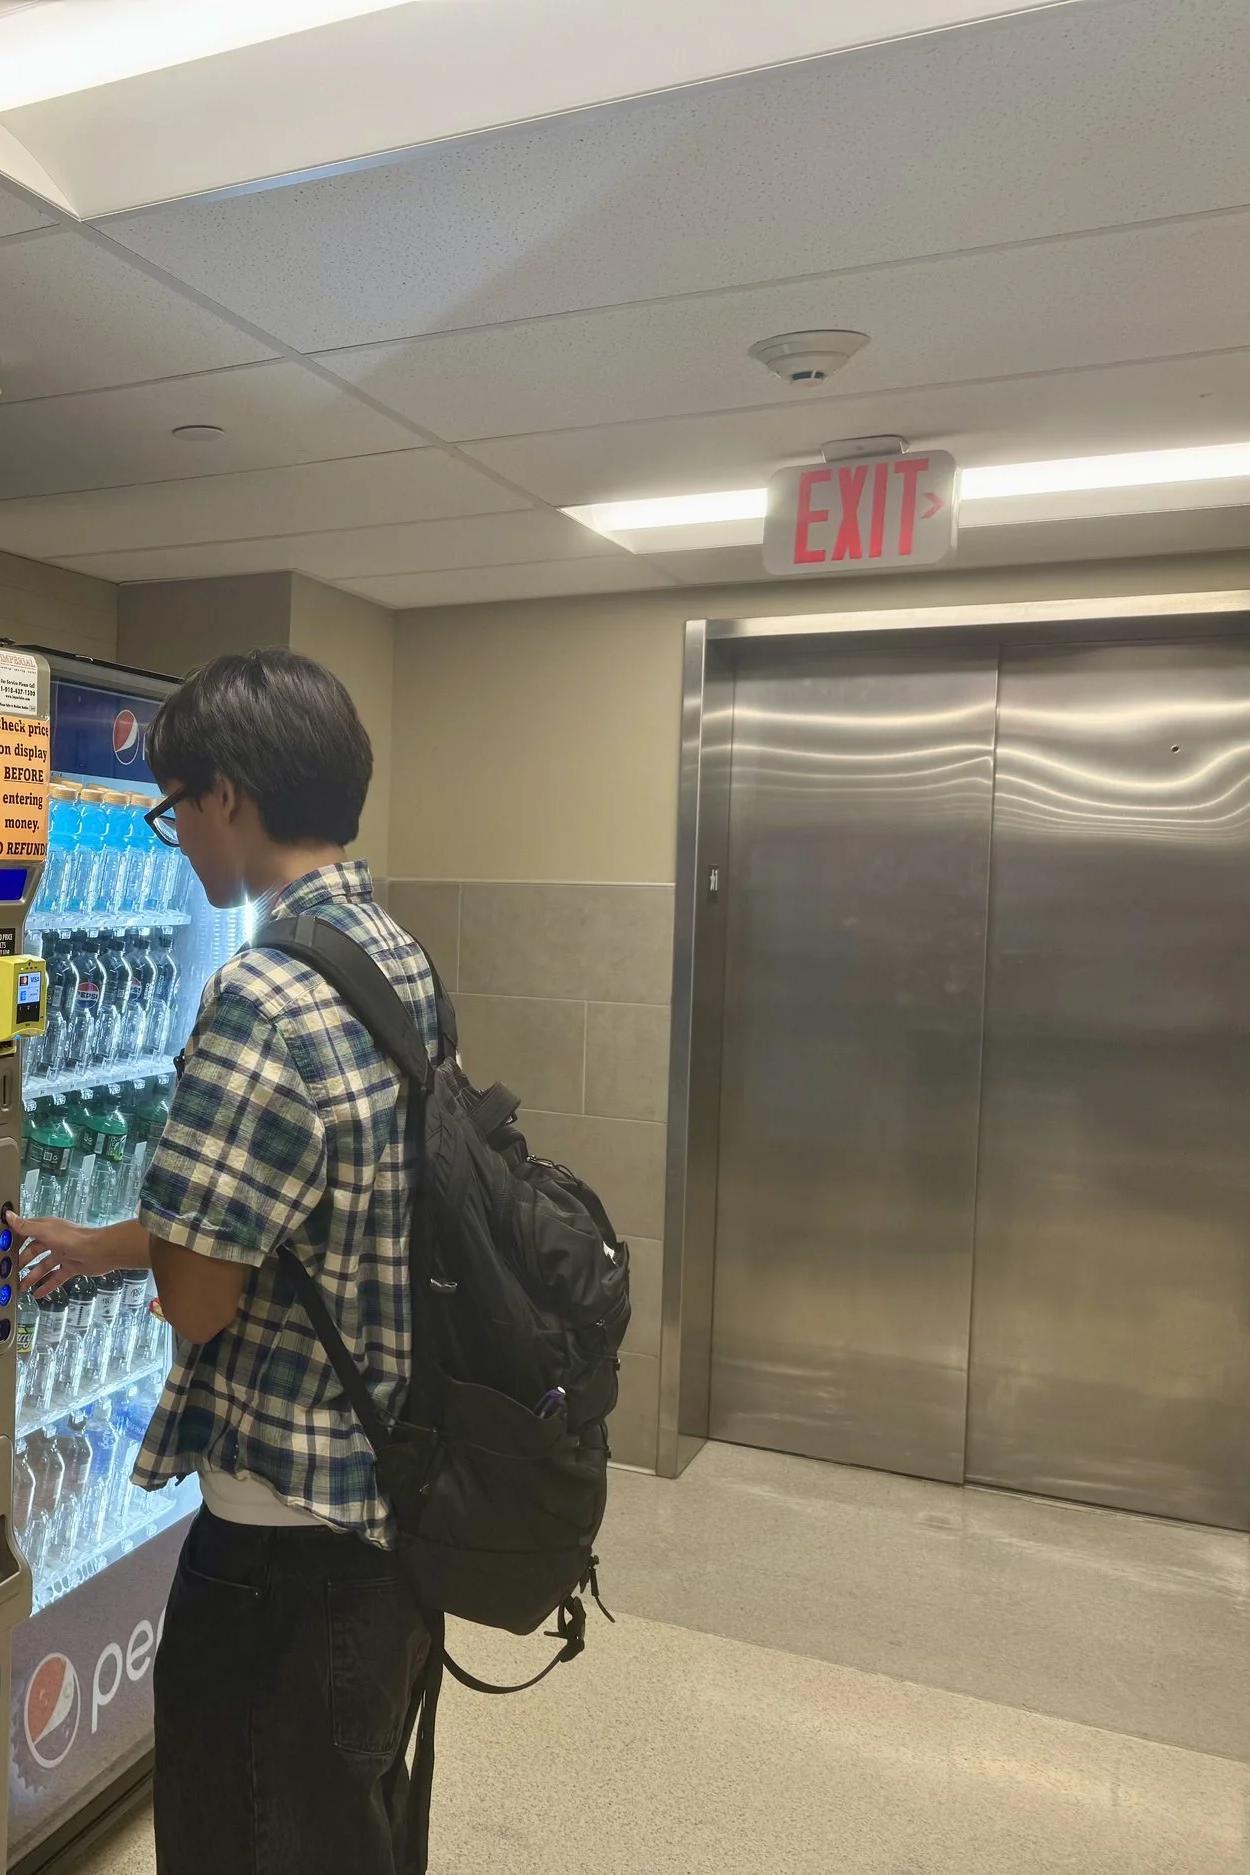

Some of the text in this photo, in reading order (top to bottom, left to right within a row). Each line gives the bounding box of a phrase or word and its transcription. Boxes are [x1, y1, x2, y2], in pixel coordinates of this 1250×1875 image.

[794, 458, 929, 564] EXIT
[14, 743, 48, 763] display
[3, 765, 44, 783] BEFORE
[2, 792, 43, 810] entering
[4, 816, 40, 832] money.
[3, 933, 13, 942] PRICE
